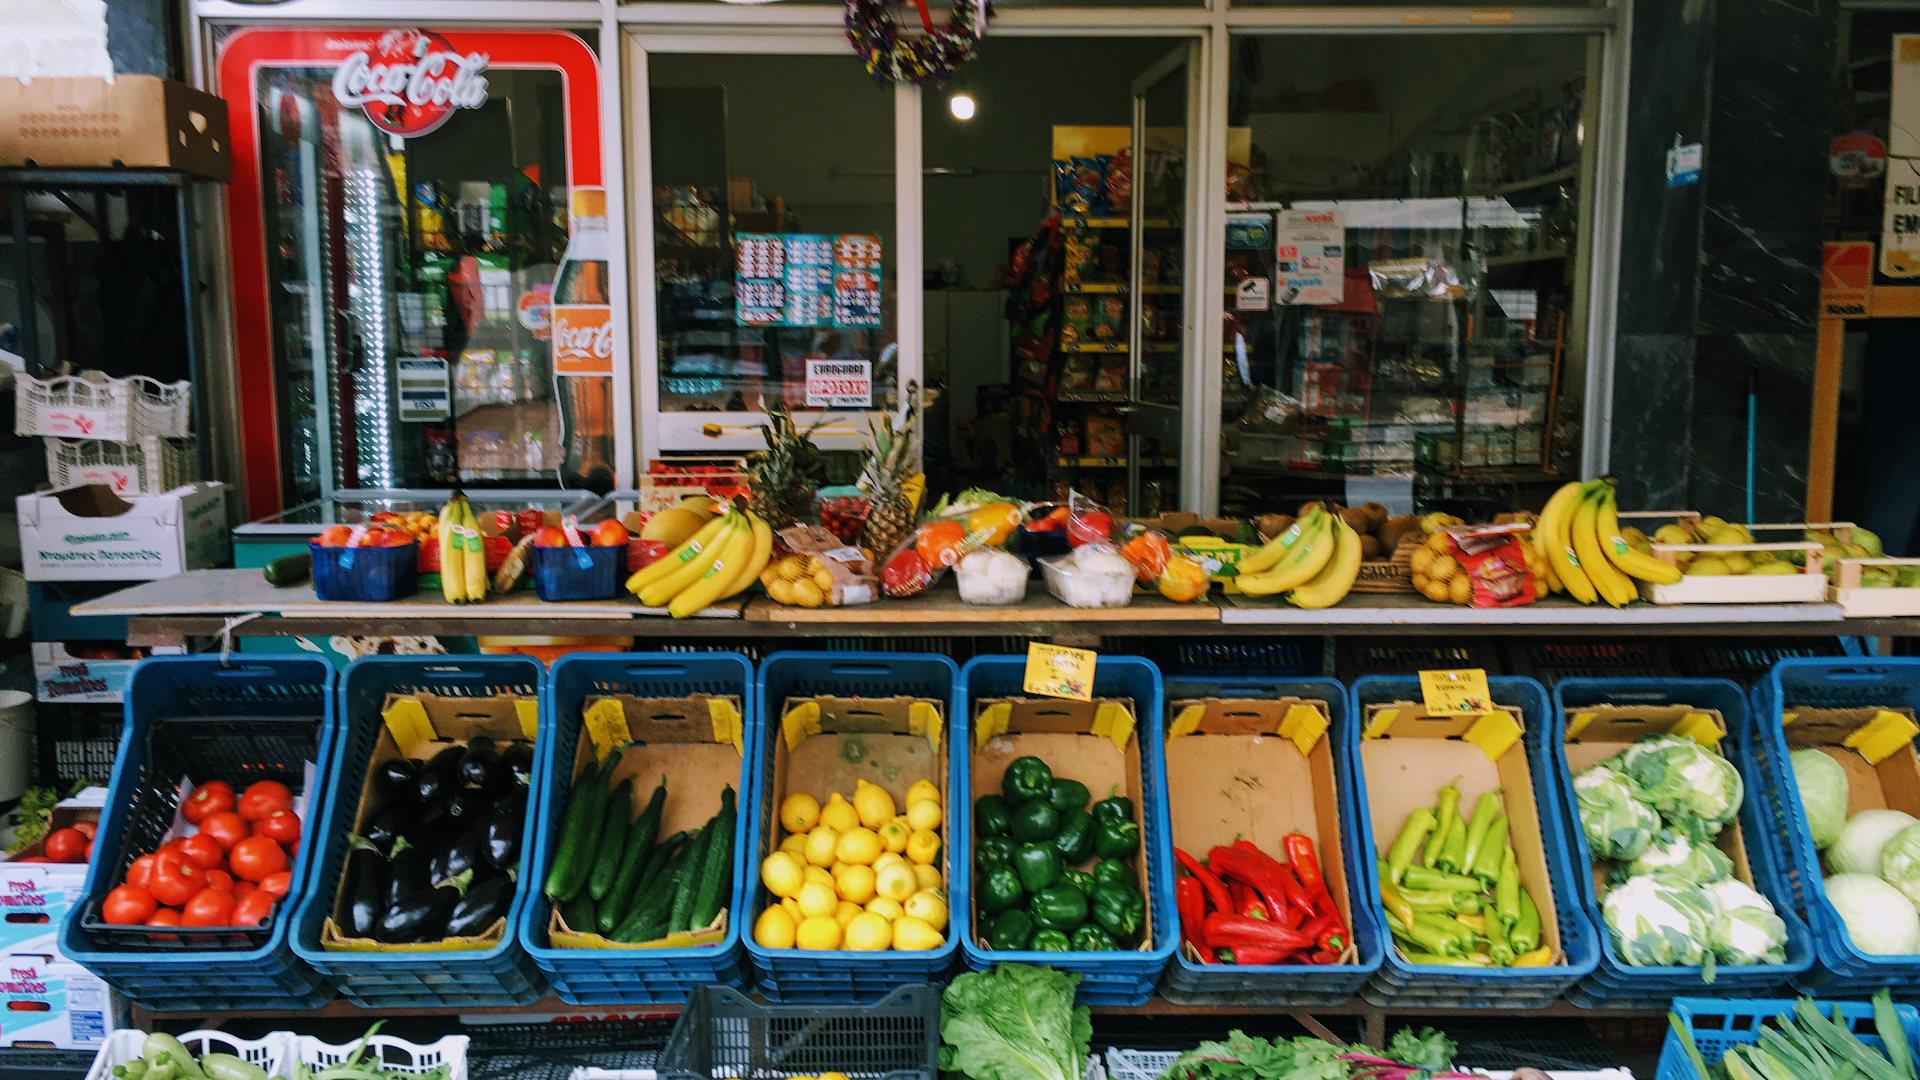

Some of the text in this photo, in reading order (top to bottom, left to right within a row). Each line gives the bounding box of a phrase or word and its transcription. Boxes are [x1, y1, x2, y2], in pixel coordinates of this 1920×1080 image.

[332, 51, 490, 109] Coca-Cola
[1892, 213, 1920, 235] EM
[1826, 303, 1867, 315] Kodak
[8, 879, 37, 893] Fresh
[0, 891, 46, 907] omatoes
[10, 966, 38, 981] Fresh
[0, 980, 48, 994] omatoes
